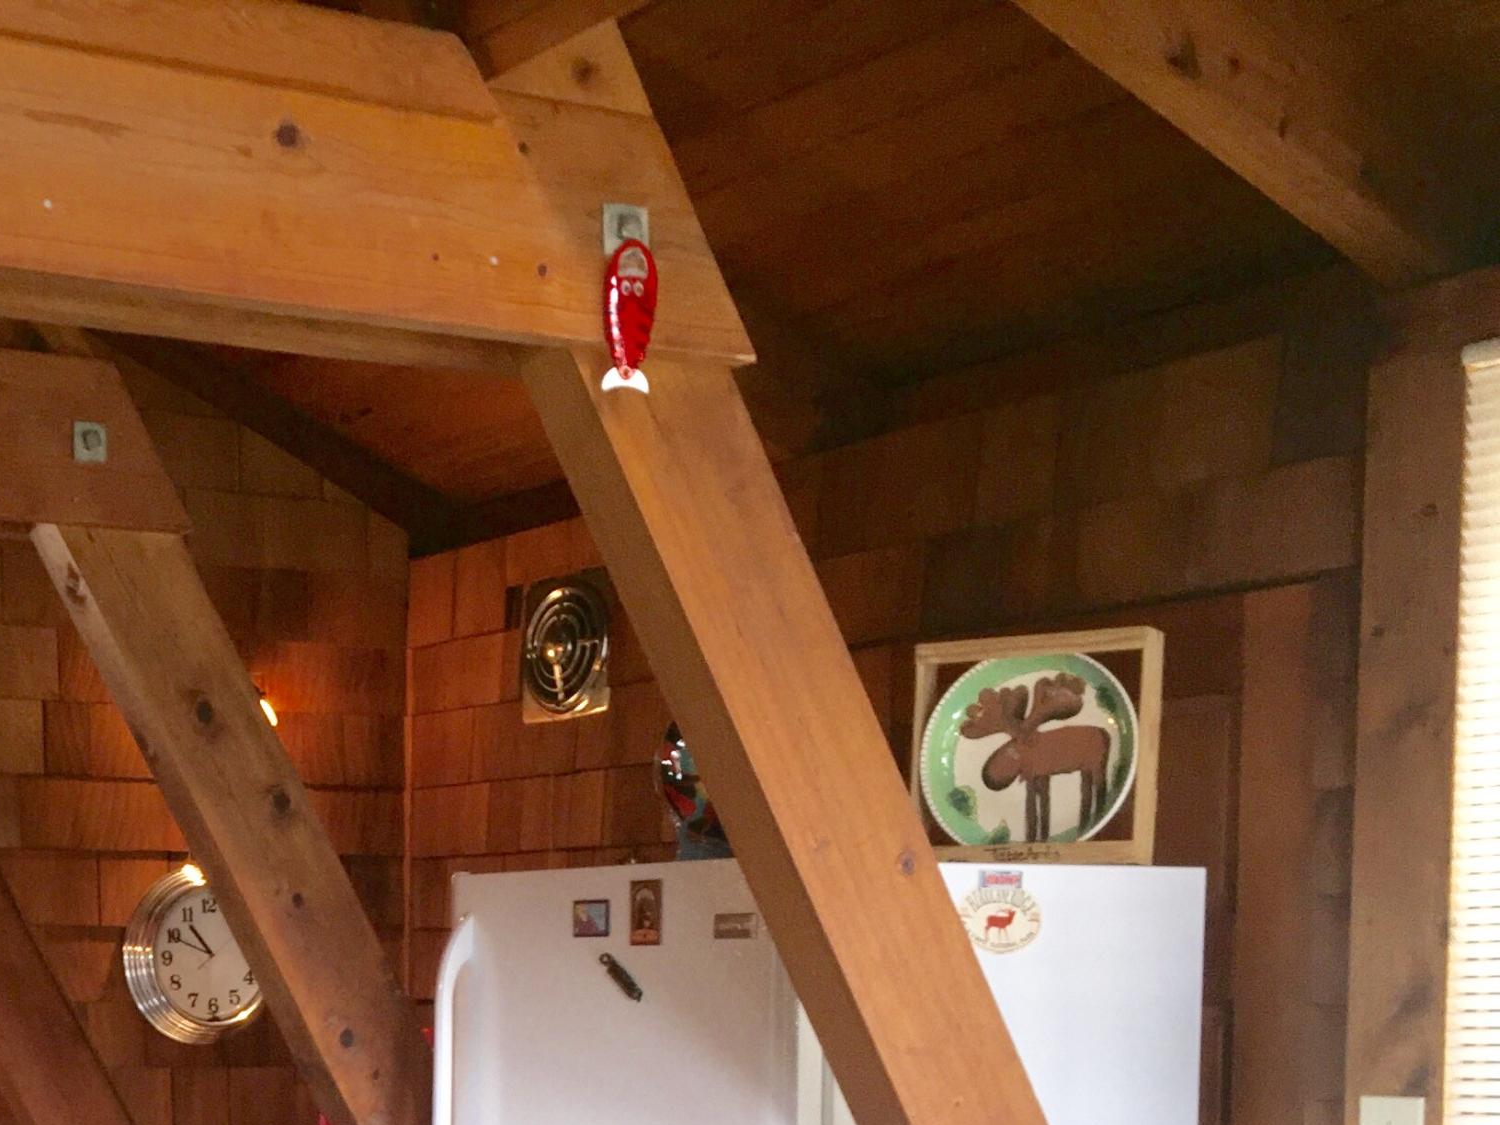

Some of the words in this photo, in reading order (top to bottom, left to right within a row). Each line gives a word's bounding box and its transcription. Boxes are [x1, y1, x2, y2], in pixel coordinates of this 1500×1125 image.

[201, 898, 217, 913] 12
[181, 907, 194, 922] 11
[167, 927, 181, 944] 10
[161, 950, 173, 967] 9
[170, 974, 182, 991] 8
[243, 969, 255, 985] 4
[187, 992, 199, 1008] 7
[208, 997, 219, 1014] 6
[228, 989, 241, 1006] 5
